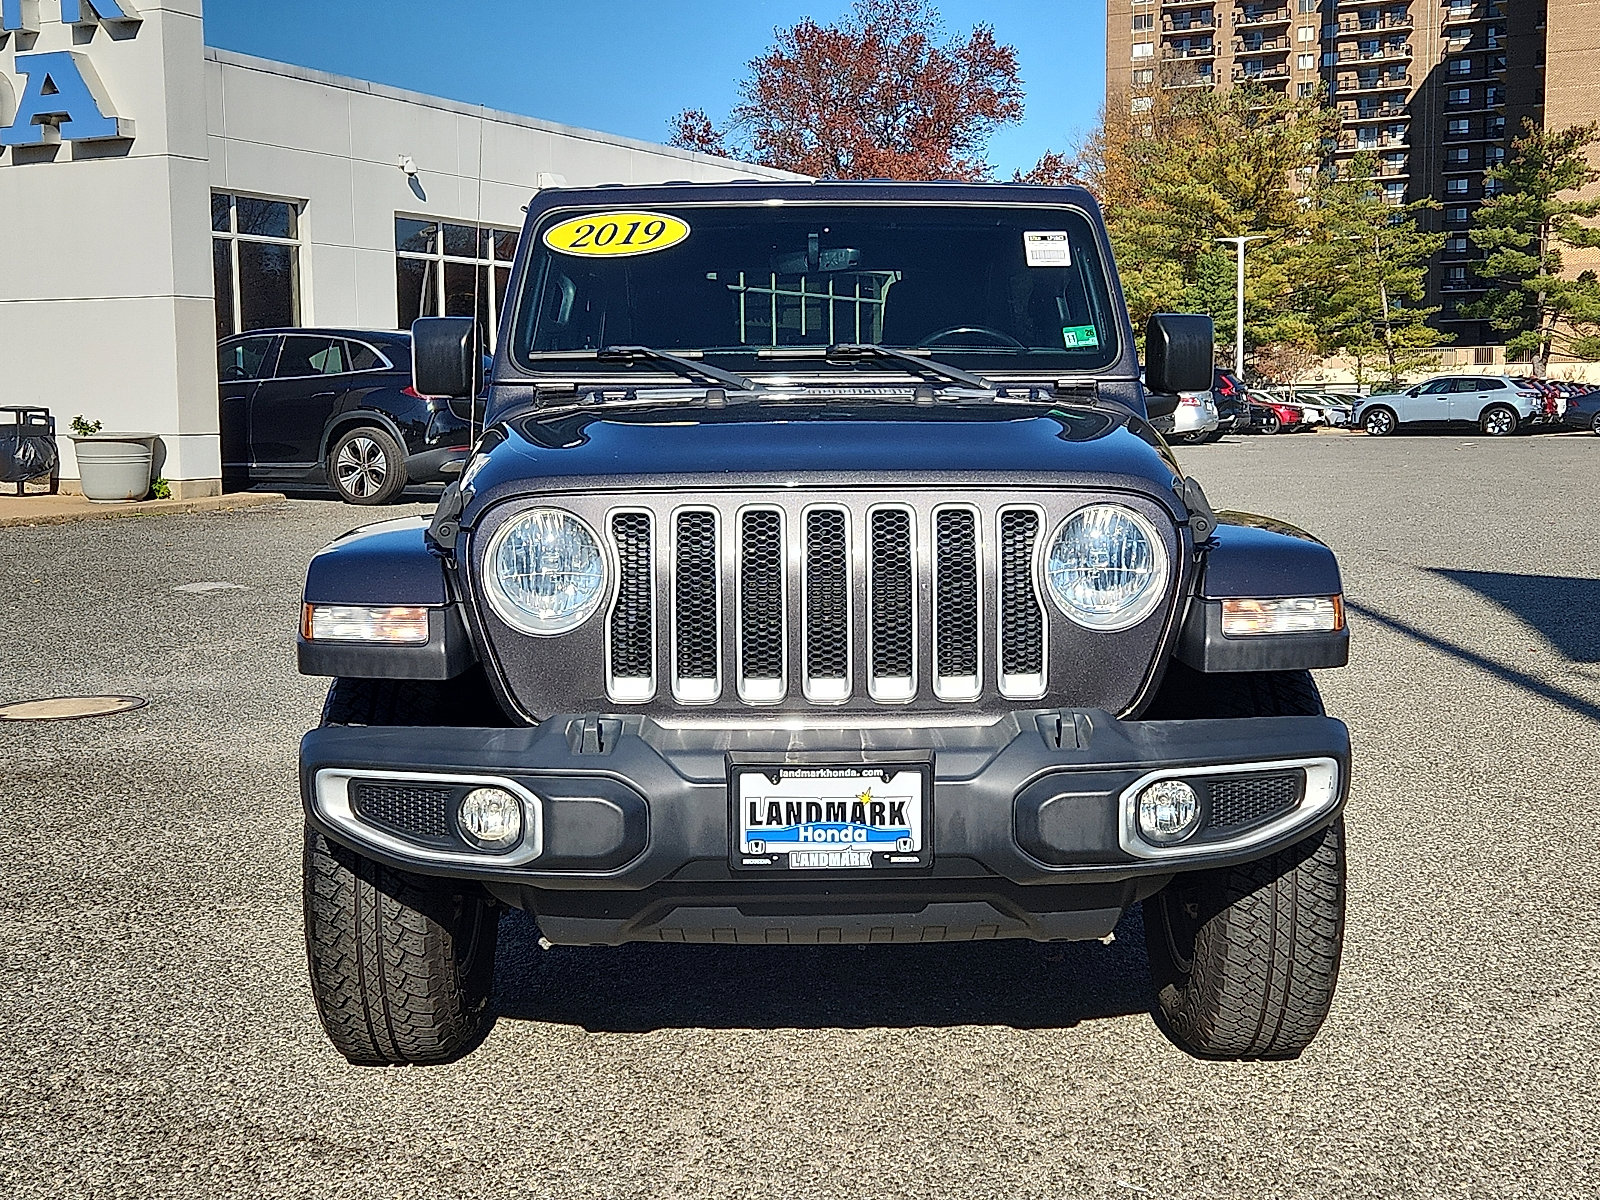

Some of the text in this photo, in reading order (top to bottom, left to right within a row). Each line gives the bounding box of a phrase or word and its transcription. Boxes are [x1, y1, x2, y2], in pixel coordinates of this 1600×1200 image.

[569, 220, 666, 248] 2019
[1067, 334, 1076, 344] 11
[750, 801, 906, 826] LANDMARK
[799, 826, 868, 843] Honda
[791, 852, 870, 867] LANDMARK
